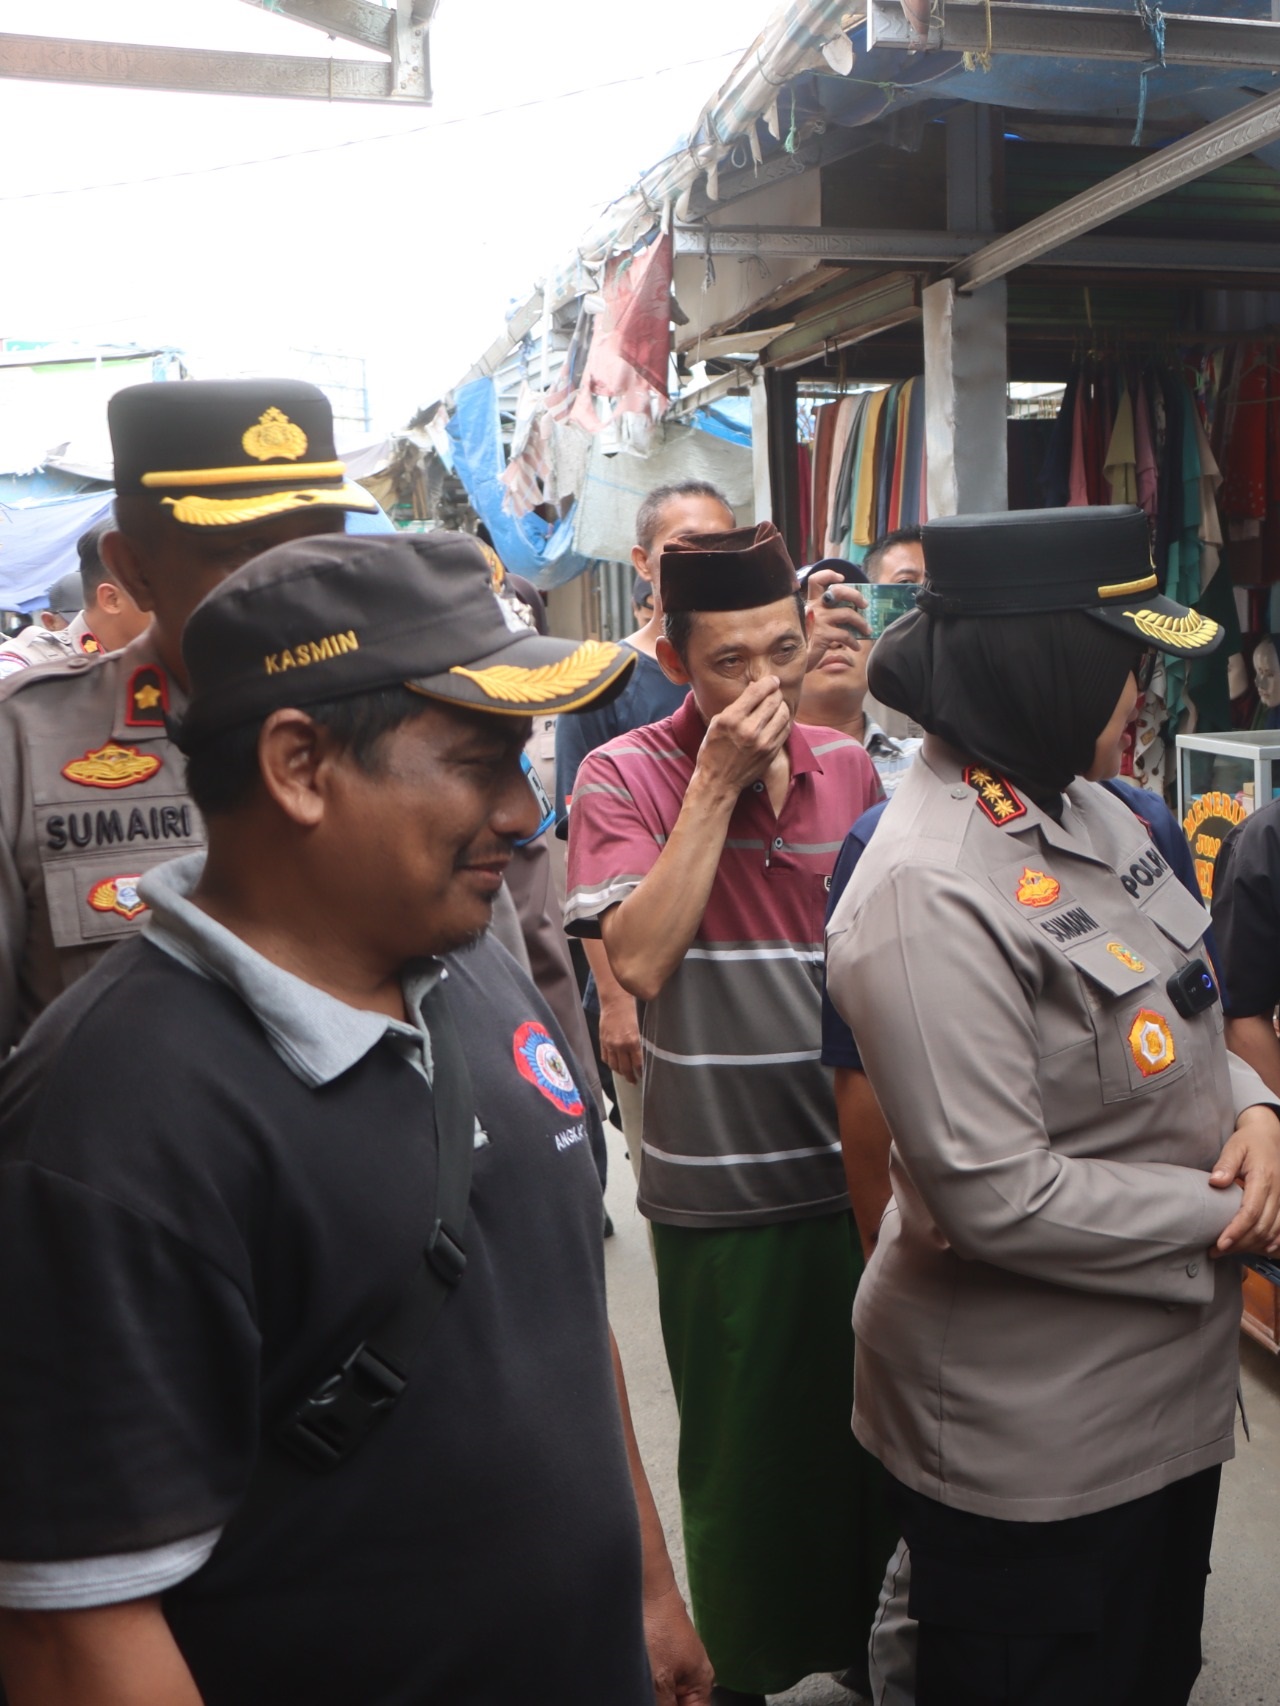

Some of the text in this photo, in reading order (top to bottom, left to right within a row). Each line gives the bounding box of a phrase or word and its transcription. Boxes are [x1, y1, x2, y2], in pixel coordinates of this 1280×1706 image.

[265, 630, 359, 675] KASMIN
[46, 804, 191, 849] SUMAIRI
[1120, 847, 1169, 899] POLRI
[1040, 906, 1100, 942] SUMARNI
